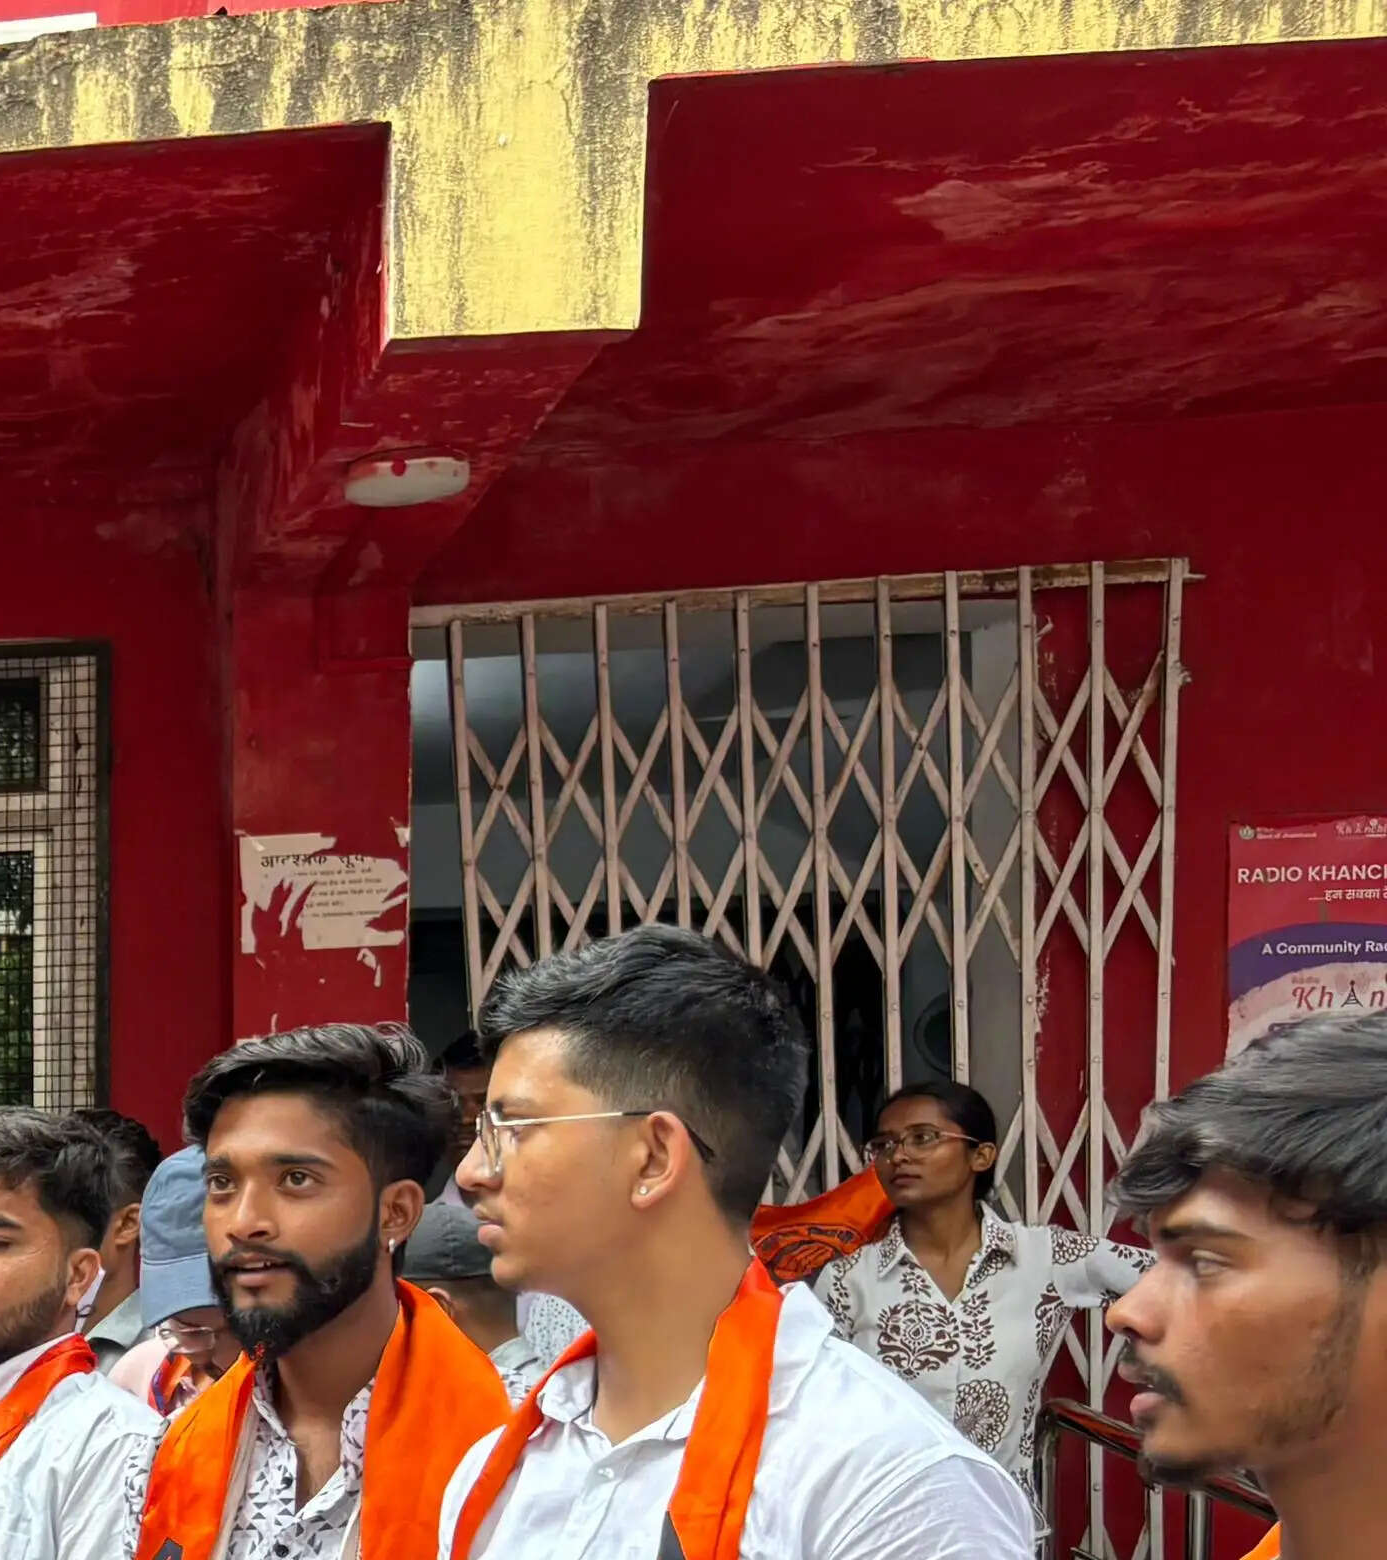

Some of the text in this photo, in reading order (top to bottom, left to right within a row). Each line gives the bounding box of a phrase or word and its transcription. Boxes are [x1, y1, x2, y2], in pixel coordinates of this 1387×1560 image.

[1237, 863, 1387, 884] RADIO KHANC
[1262, 943, 1273, 955] A
[1276, 940, 1361, 955] Community
